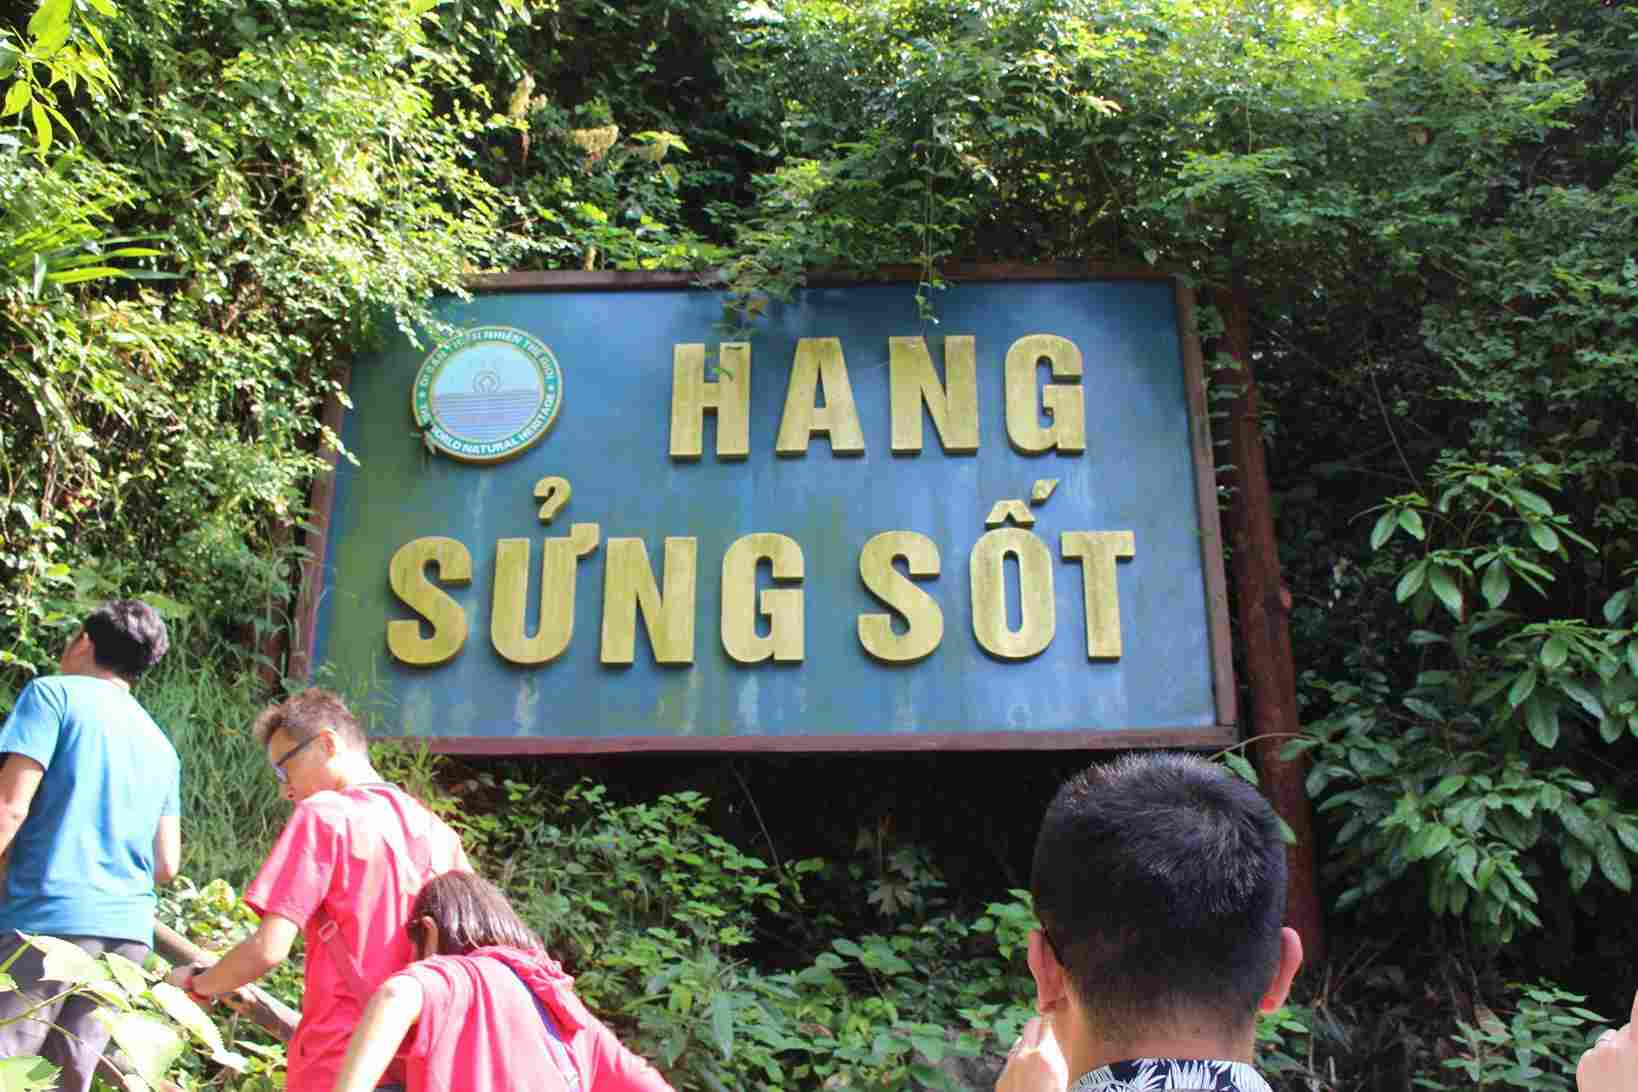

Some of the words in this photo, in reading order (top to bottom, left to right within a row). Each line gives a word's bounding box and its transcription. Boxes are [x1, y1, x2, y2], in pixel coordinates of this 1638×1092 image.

[463, 435, 521, 455] NATURAL
[669, 334, 1087, 457] HANG
[387, 476, 804, 665] SỬNG
[857, 480, 1136, 663] SỐT
